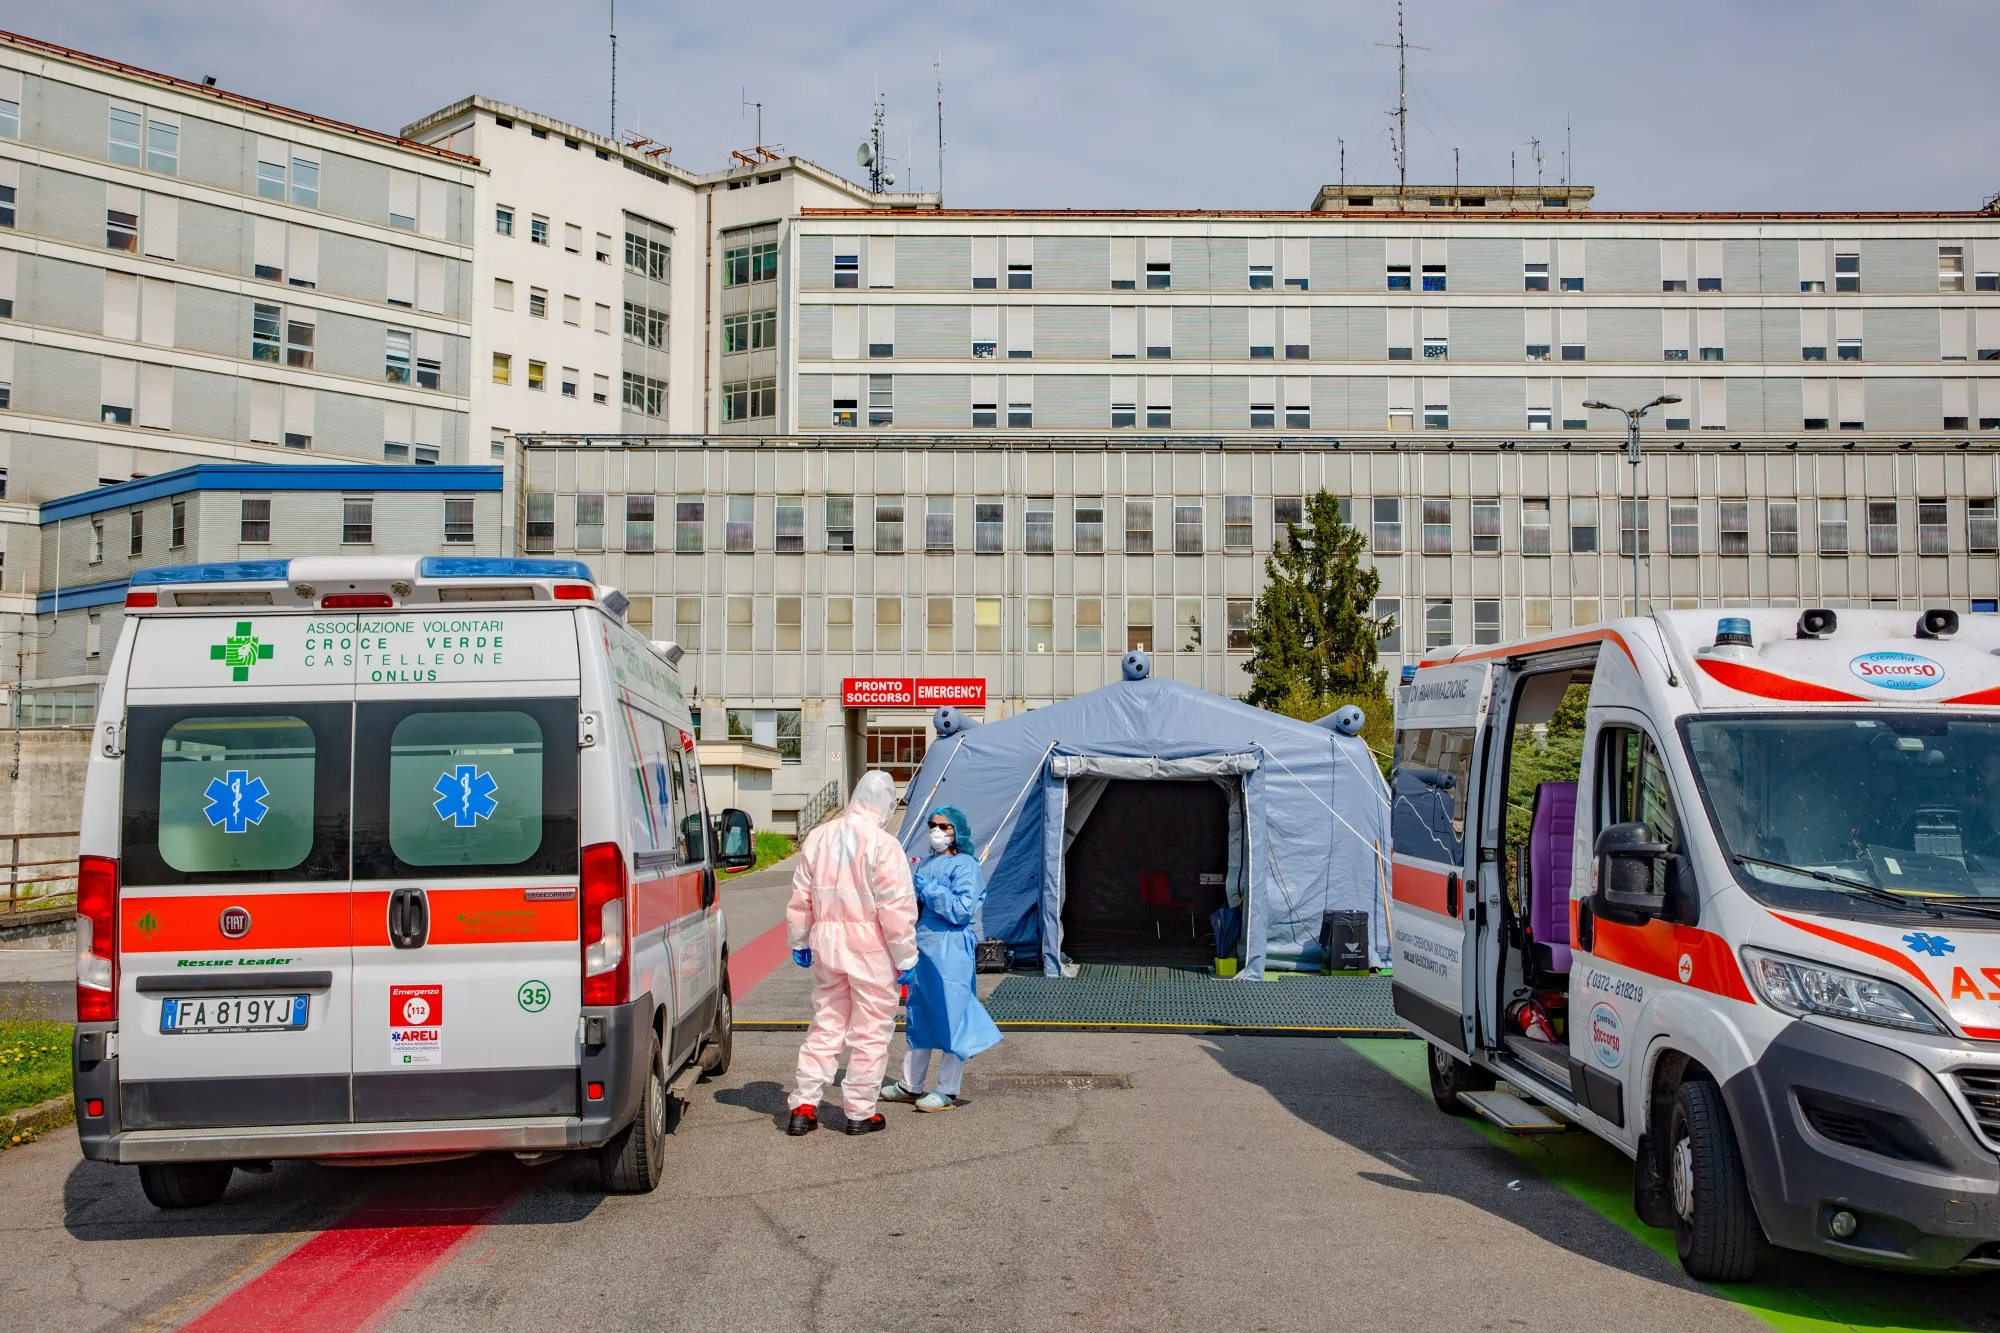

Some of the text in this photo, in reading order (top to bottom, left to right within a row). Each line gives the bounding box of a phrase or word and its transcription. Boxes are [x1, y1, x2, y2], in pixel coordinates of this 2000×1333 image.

[306, 620, 503, 634] ASSOCIAZIONE VOLONTARI
[305, 637, 503, 650] CROCE VERDE
[304, 652, 503, 667] CASTELLEONE
[1869, 654, 1915, 662] Cremona
[371, 670, 437, 681] ONLUS
[855, 681, 903, 691] PRONTO
[1886, 679, 1918, 688] Onlus
[917, 685, 982, 699] EMERGENCY
[1419, 679, 1469, 702] RIANIMAZIONE
[846, 693, 911, 703] SOCCORSO
[226, 915, 244, 930] FIAT
[177, 957, 293, 967] Rescue Leader
[393, 988, 439, 996] Emergenza
[1592, 973, 1609, 991] 0372
[1615, 980, 1643, 1002] 818219
[522, 988, 547, 1005] 35
[178, 1000, 291, 1025] FA 819YJ
[411, 1007, 425, 1015] 112
[401, 1030, 438, 1041] AREU
